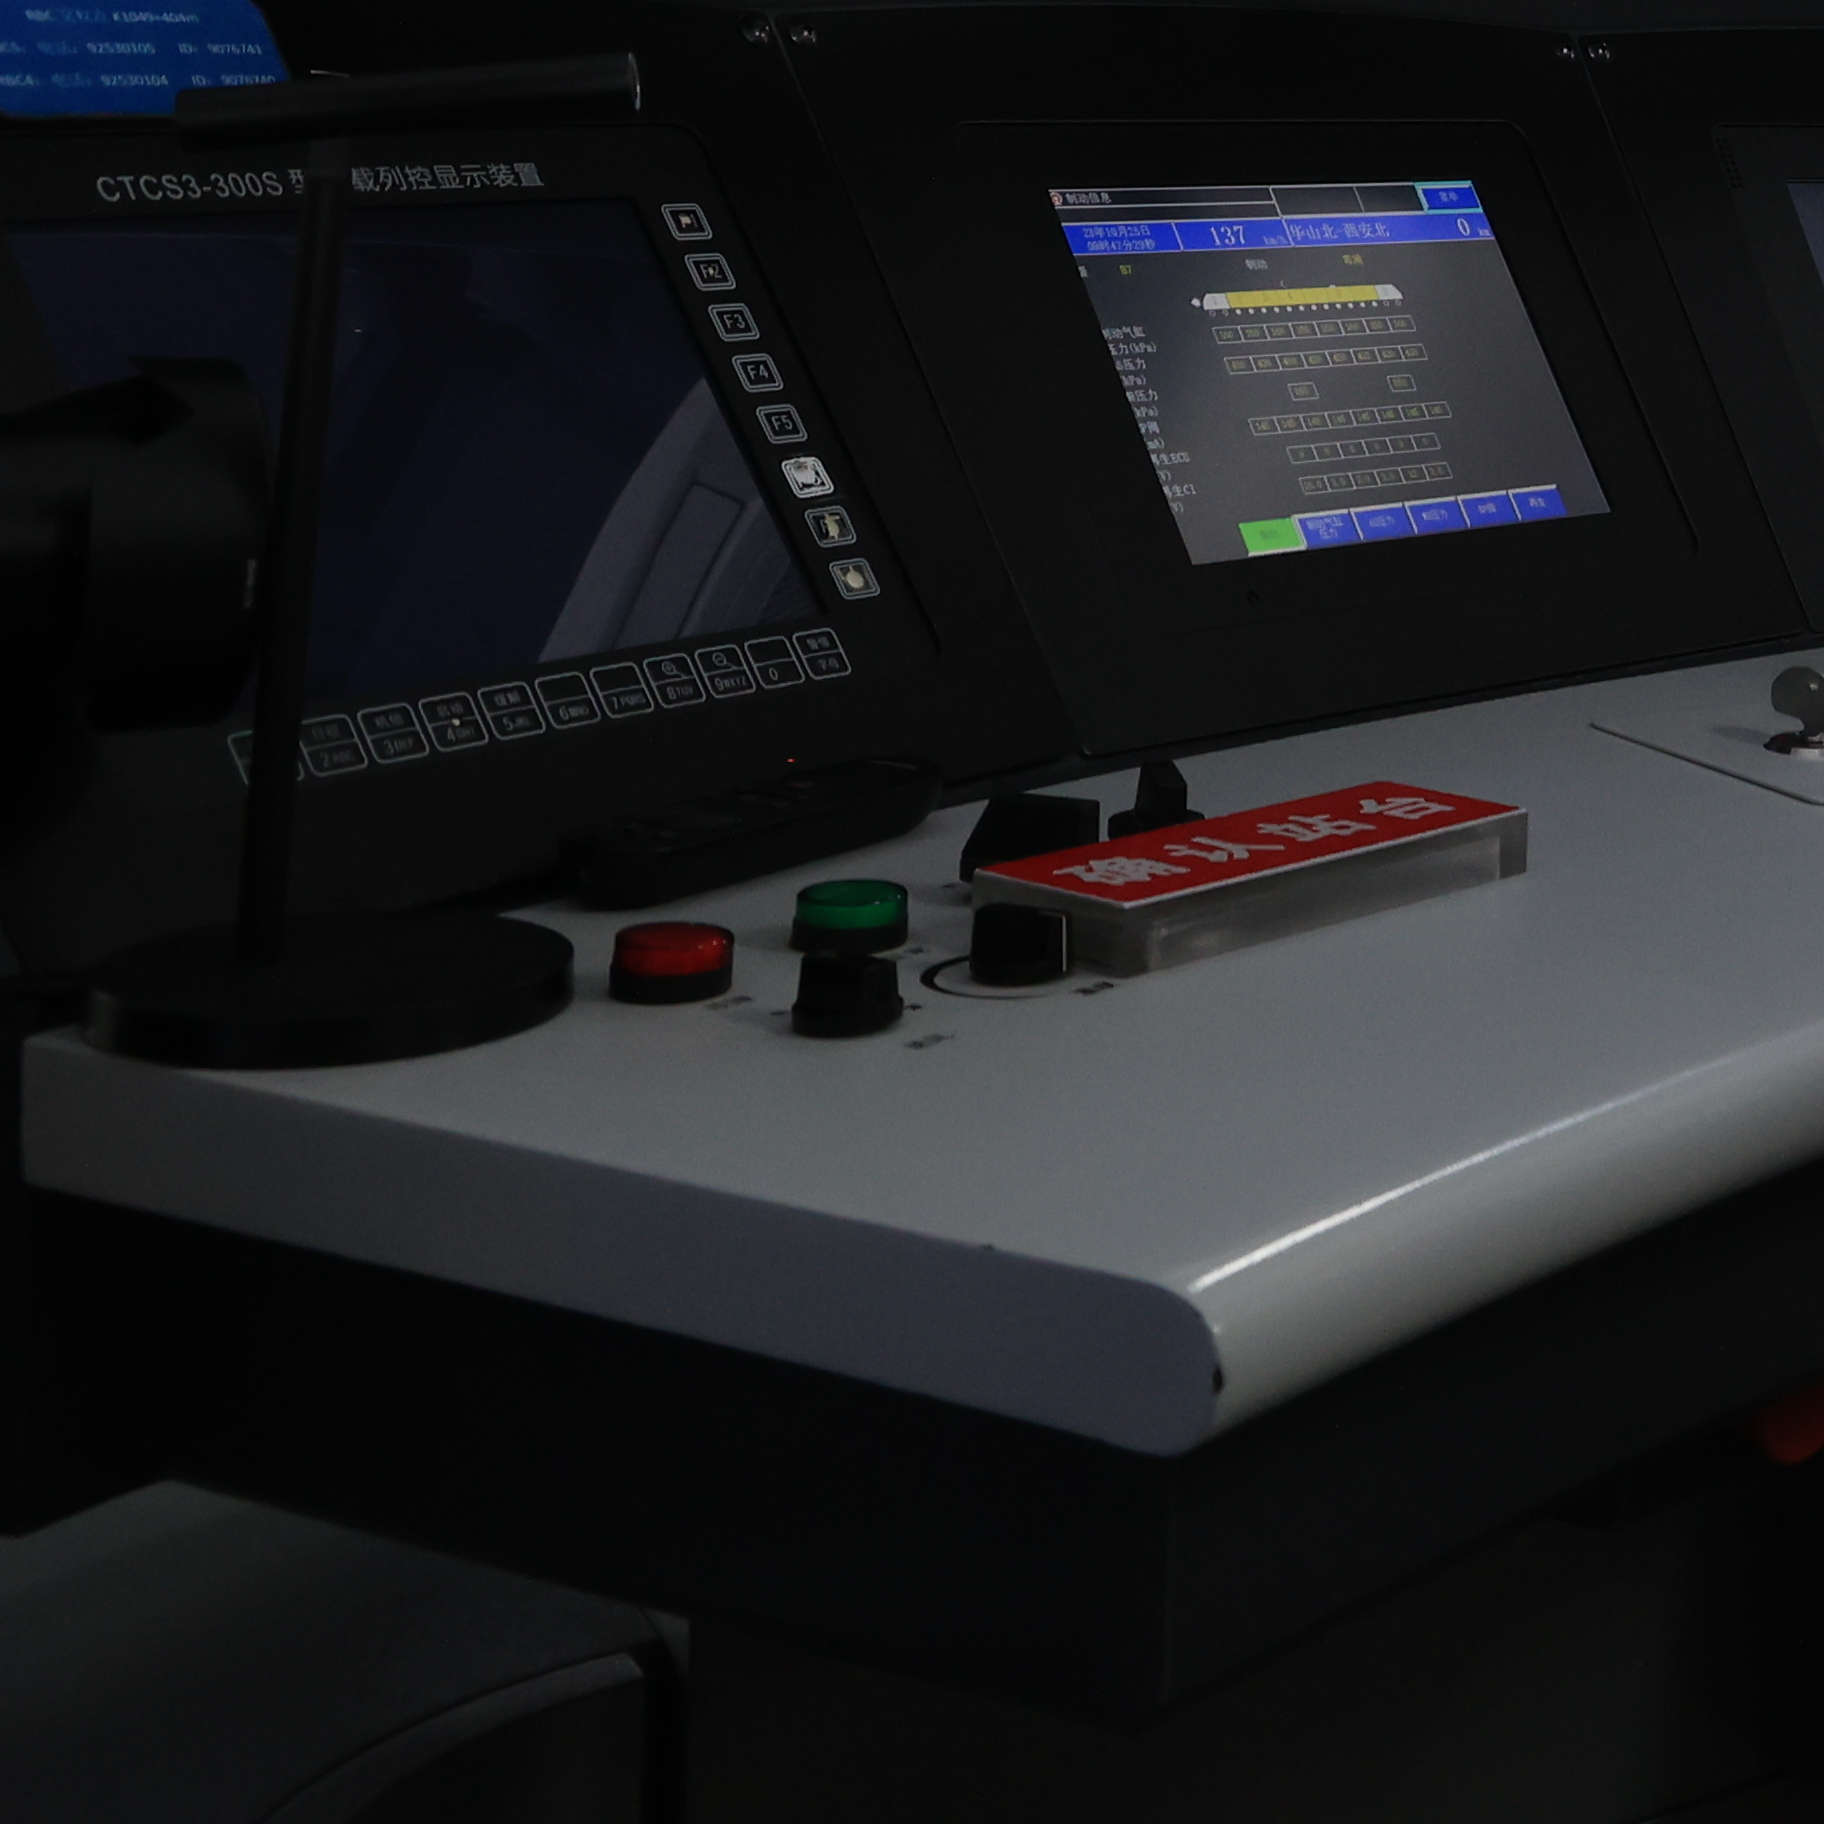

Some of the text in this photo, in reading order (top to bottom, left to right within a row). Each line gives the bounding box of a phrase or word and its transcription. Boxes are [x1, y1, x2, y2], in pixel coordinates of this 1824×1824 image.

[96, 161, 546, 203] CTCS3-300S 型载列控显示装置
[1209, 225, 1247, 247] 137
[1456, 217, 1471, 237] 0
[722, 313, 747, 331] F3
[747, 363, 770, 381] F4
[770, 414, 794, 431] F5
[768, 666, 779, 681] 0
[1053, 796, 1456, 886] 确认站台
